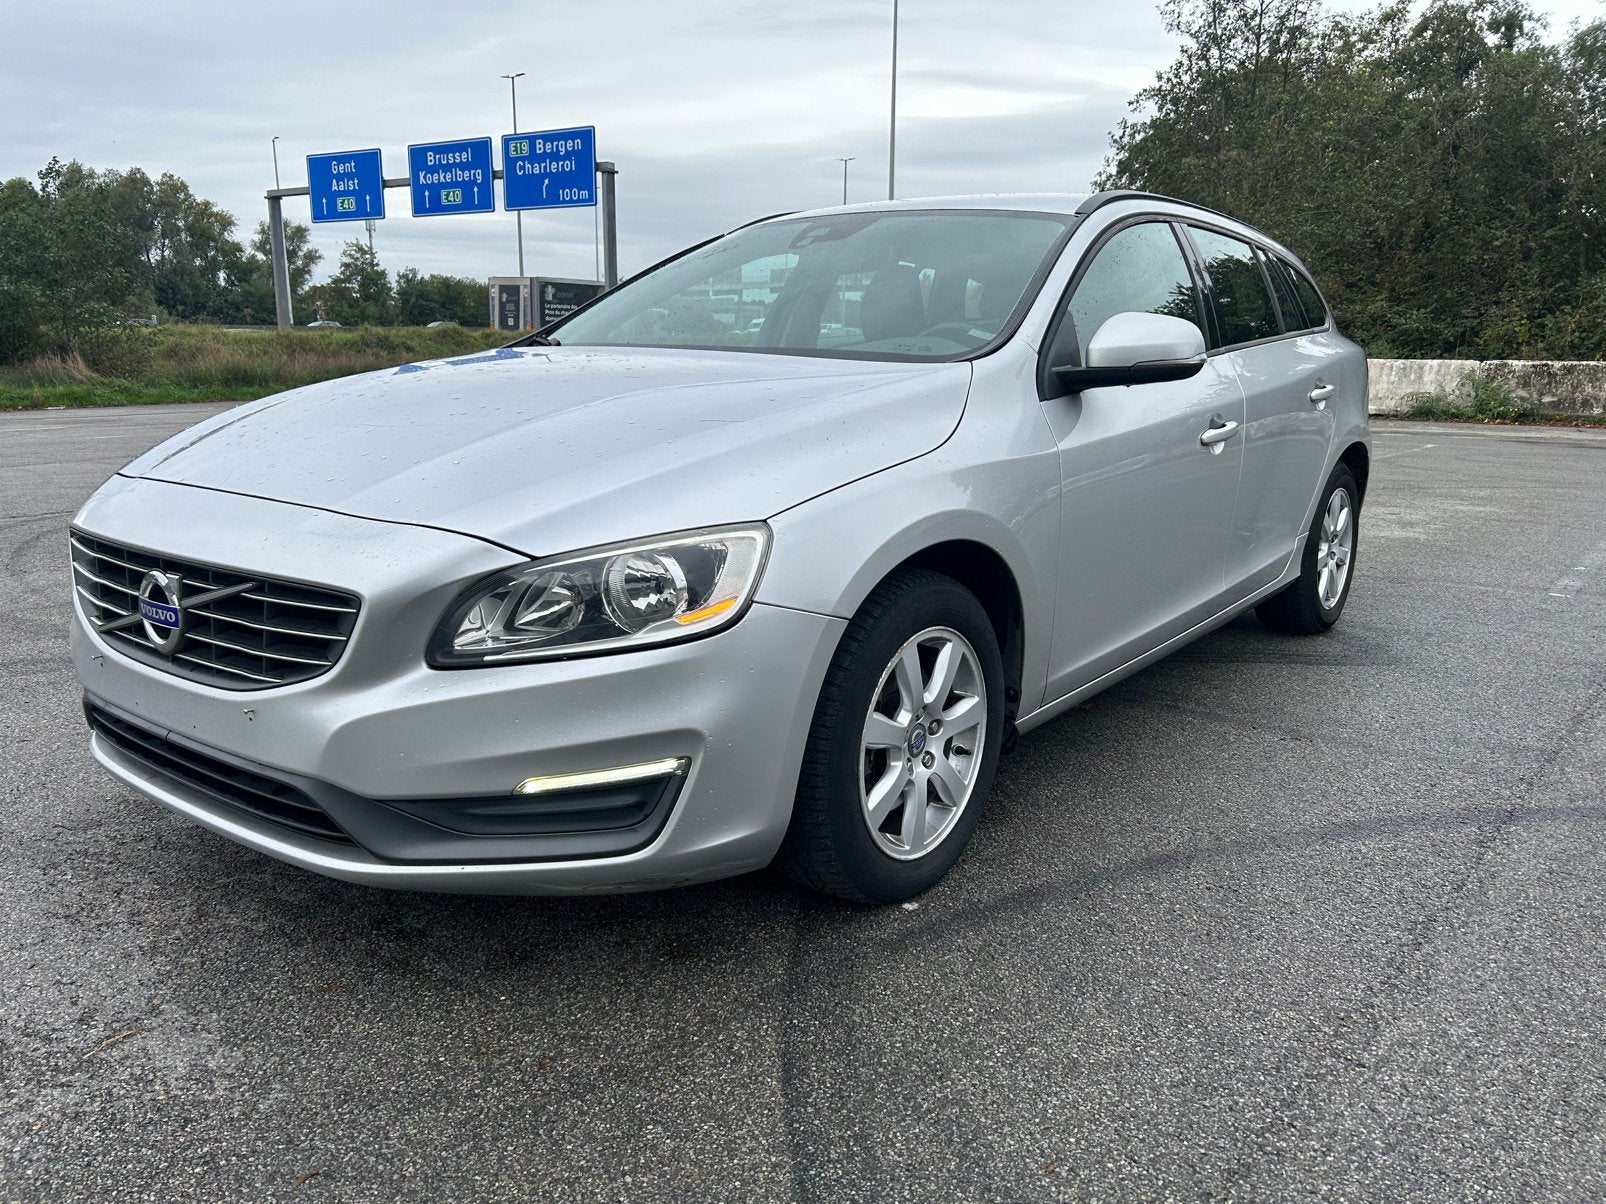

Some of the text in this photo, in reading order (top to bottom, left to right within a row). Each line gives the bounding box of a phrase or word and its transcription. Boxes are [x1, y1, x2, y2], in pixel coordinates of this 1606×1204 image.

[509, 138, 582, 155] E19 Bergen
[427, 147, 472, 166] Brussel
[331, 160, 356, 174] Gent
[516, 156, 576, 175] Charleroi
[419, 168, 482, 184] Koekelberg
[331, 178, 359, 192] Aalst
[338, 198, 355, 210] E40
[442, 190, 461, 203] E40
[140, 602, 176, 623] VOLVO
